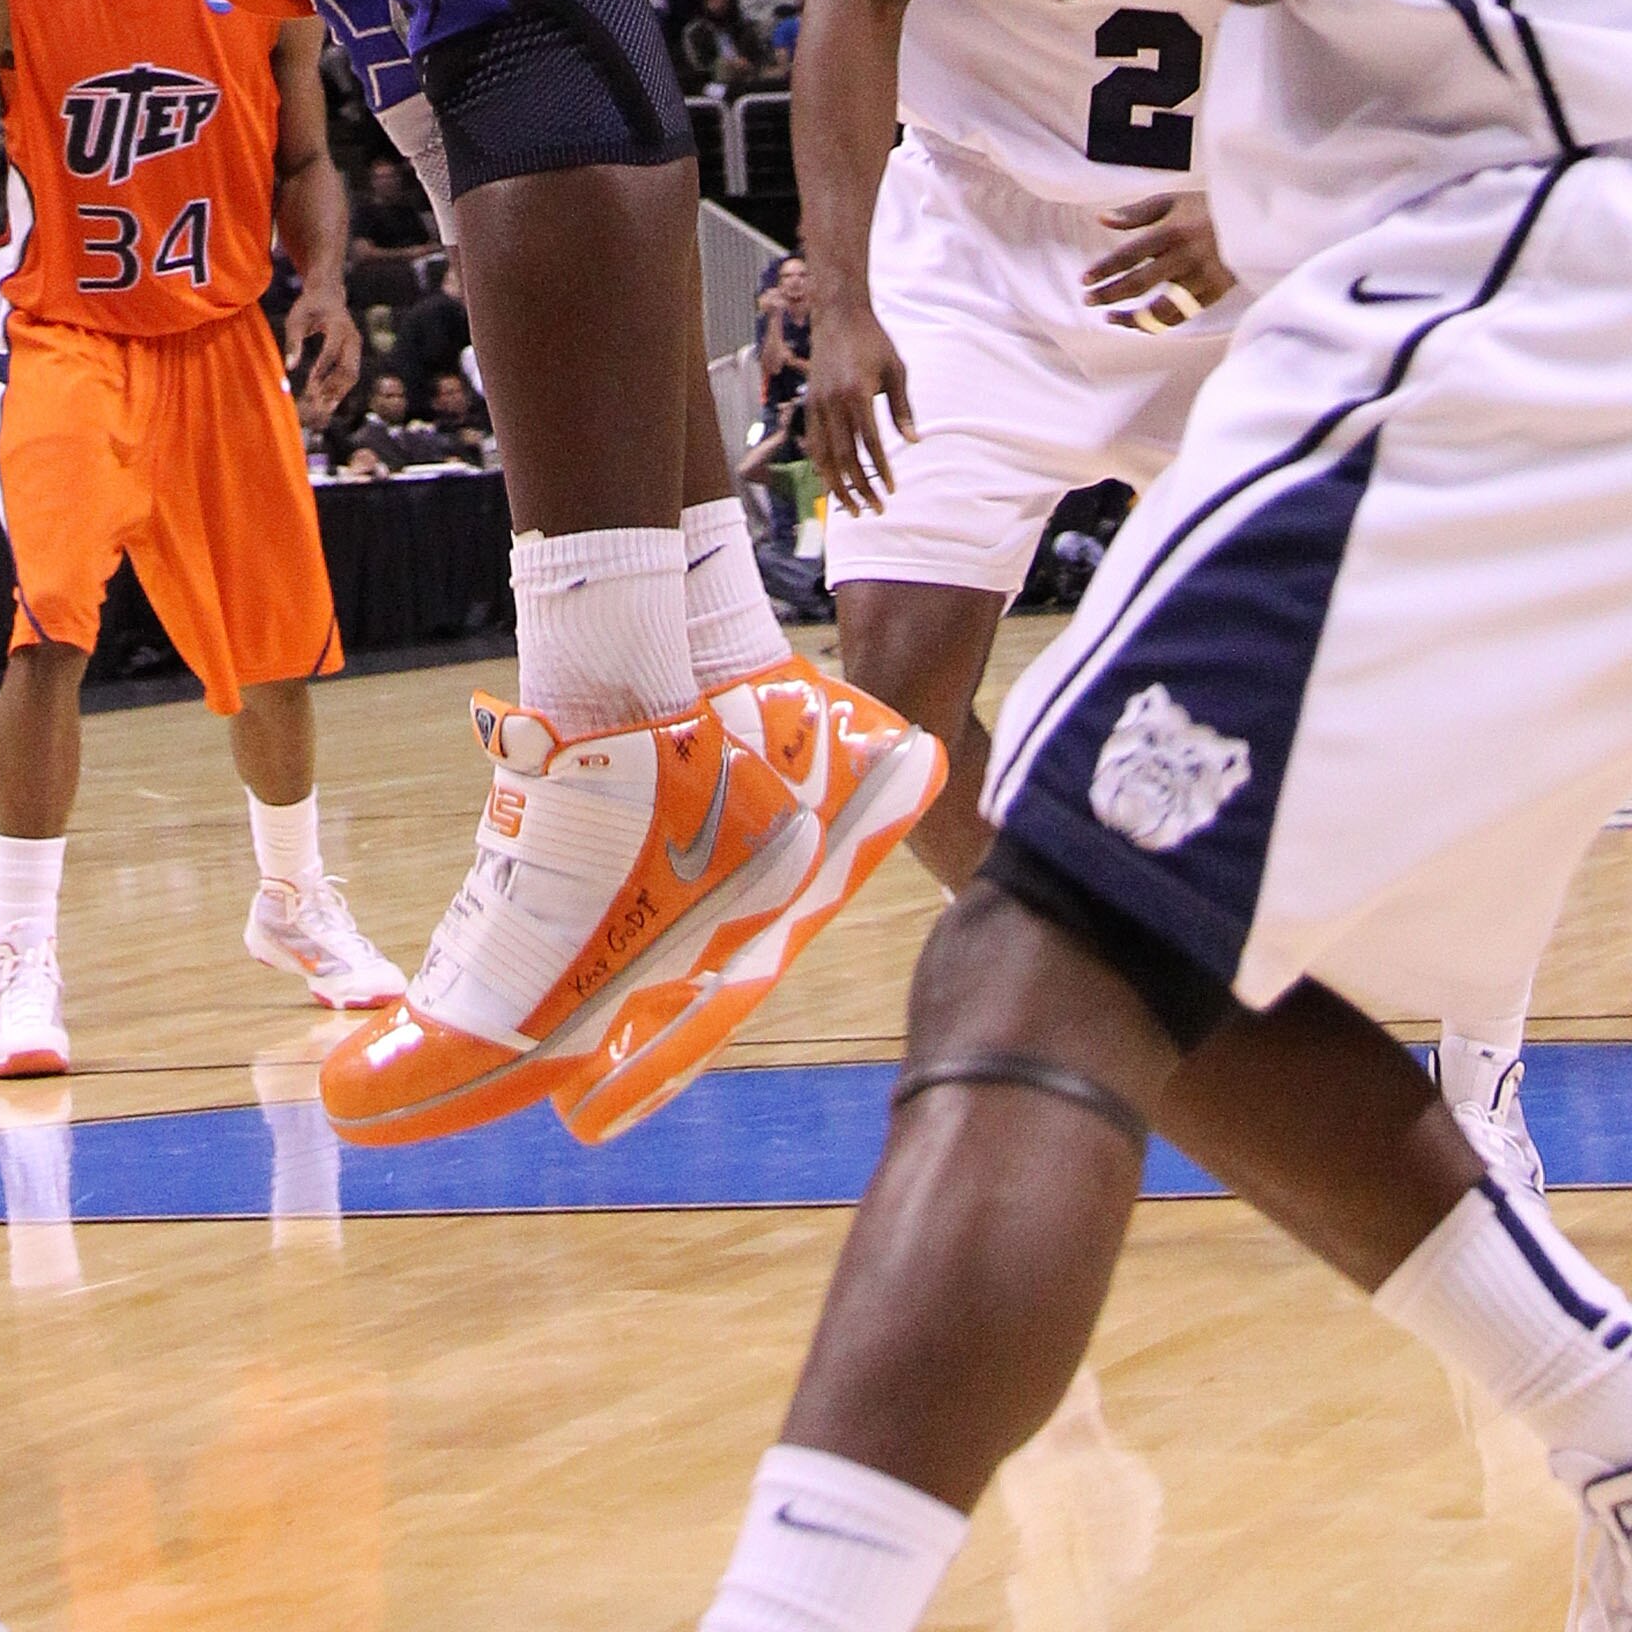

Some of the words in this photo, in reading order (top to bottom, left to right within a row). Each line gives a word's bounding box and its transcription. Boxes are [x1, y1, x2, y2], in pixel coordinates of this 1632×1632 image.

[60, 62, 223, 186] UTEP
[1086, 8, 1204, 172] 2
[76, 197, 211, 293] 34
